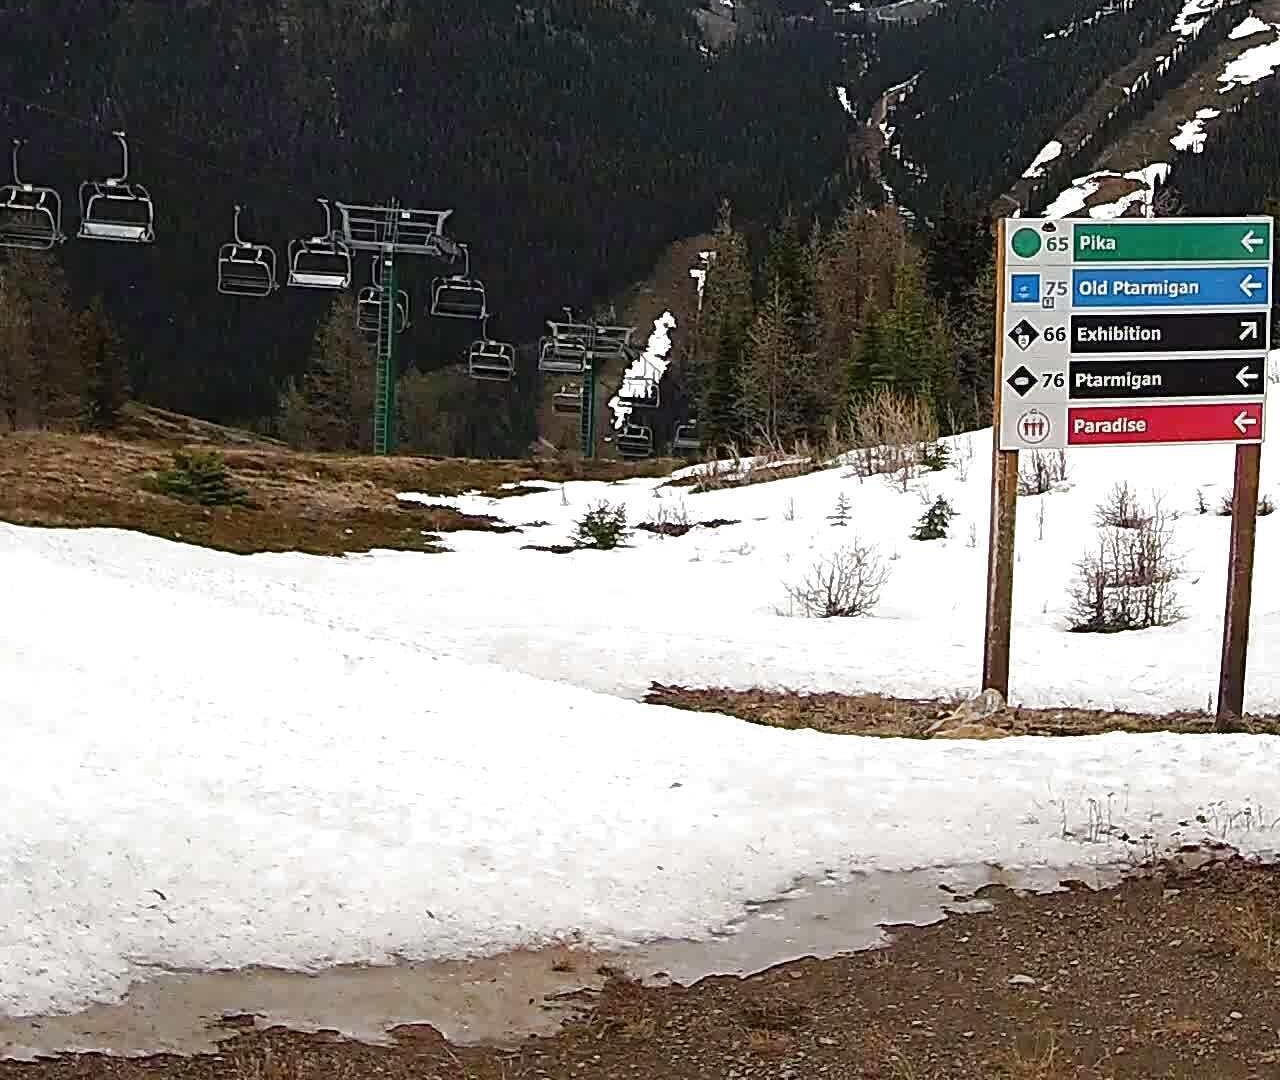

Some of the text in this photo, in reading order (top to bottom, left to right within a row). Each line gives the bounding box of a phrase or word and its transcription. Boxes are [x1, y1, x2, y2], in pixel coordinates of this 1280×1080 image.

[1046, 235, 1116, 252] 65 Pika
[1046, 280, 1199, 298] 75 Old Ptarmigan
[1044, 326, 1161, 342] 66 Exhibition
[1042, 372, 1162, 389] 76 Ptarmigan
[1074, 418, 1146, 433] Paradise
